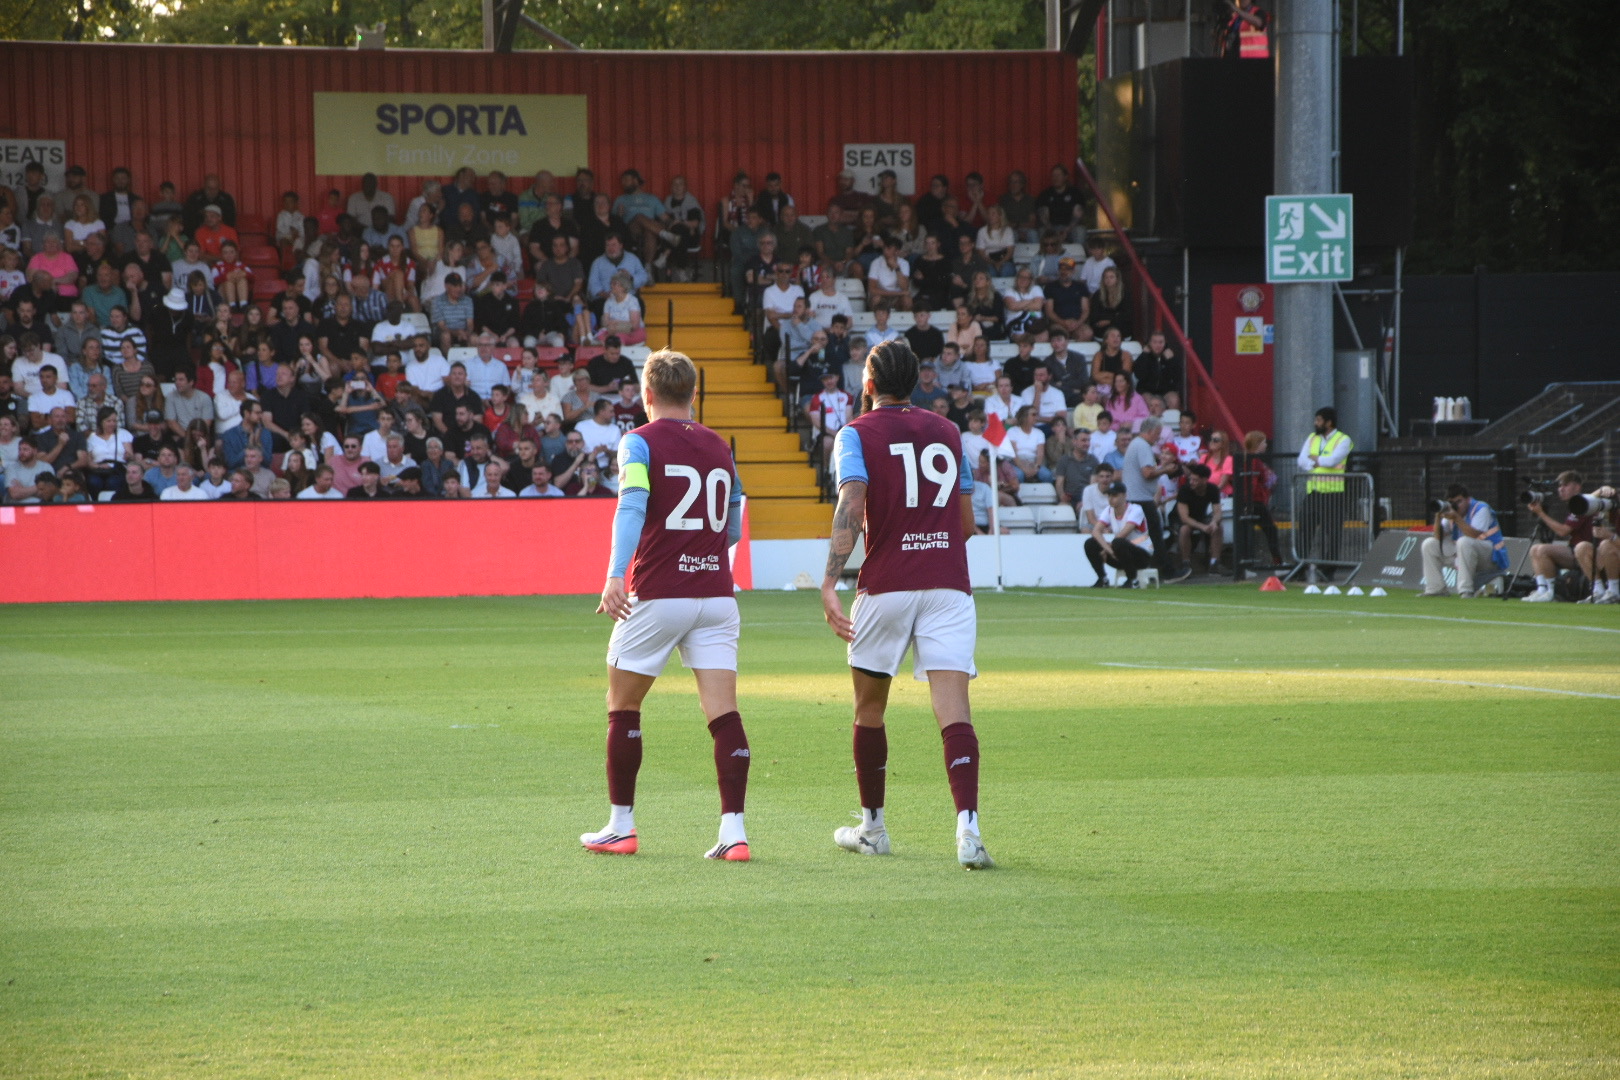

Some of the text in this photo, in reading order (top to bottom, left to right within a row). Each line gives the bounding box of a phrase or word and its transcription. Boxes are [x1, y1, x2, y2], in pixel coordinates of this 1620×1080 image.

[376, 103, 527, 136] SPORTA
[0, 146, 63, 164] EATS
[385, 144, 519, 168] Family Zone
[846, 149, 913, 167] SEATS
[1273, 243, 1345, 275] Exit
[889, 442, 958, 508] 19
[664, 464, 732, 533] 20
[902, 532, 948, 542] ATHLETES
[902, 541, 949, 551] ELEVATED
